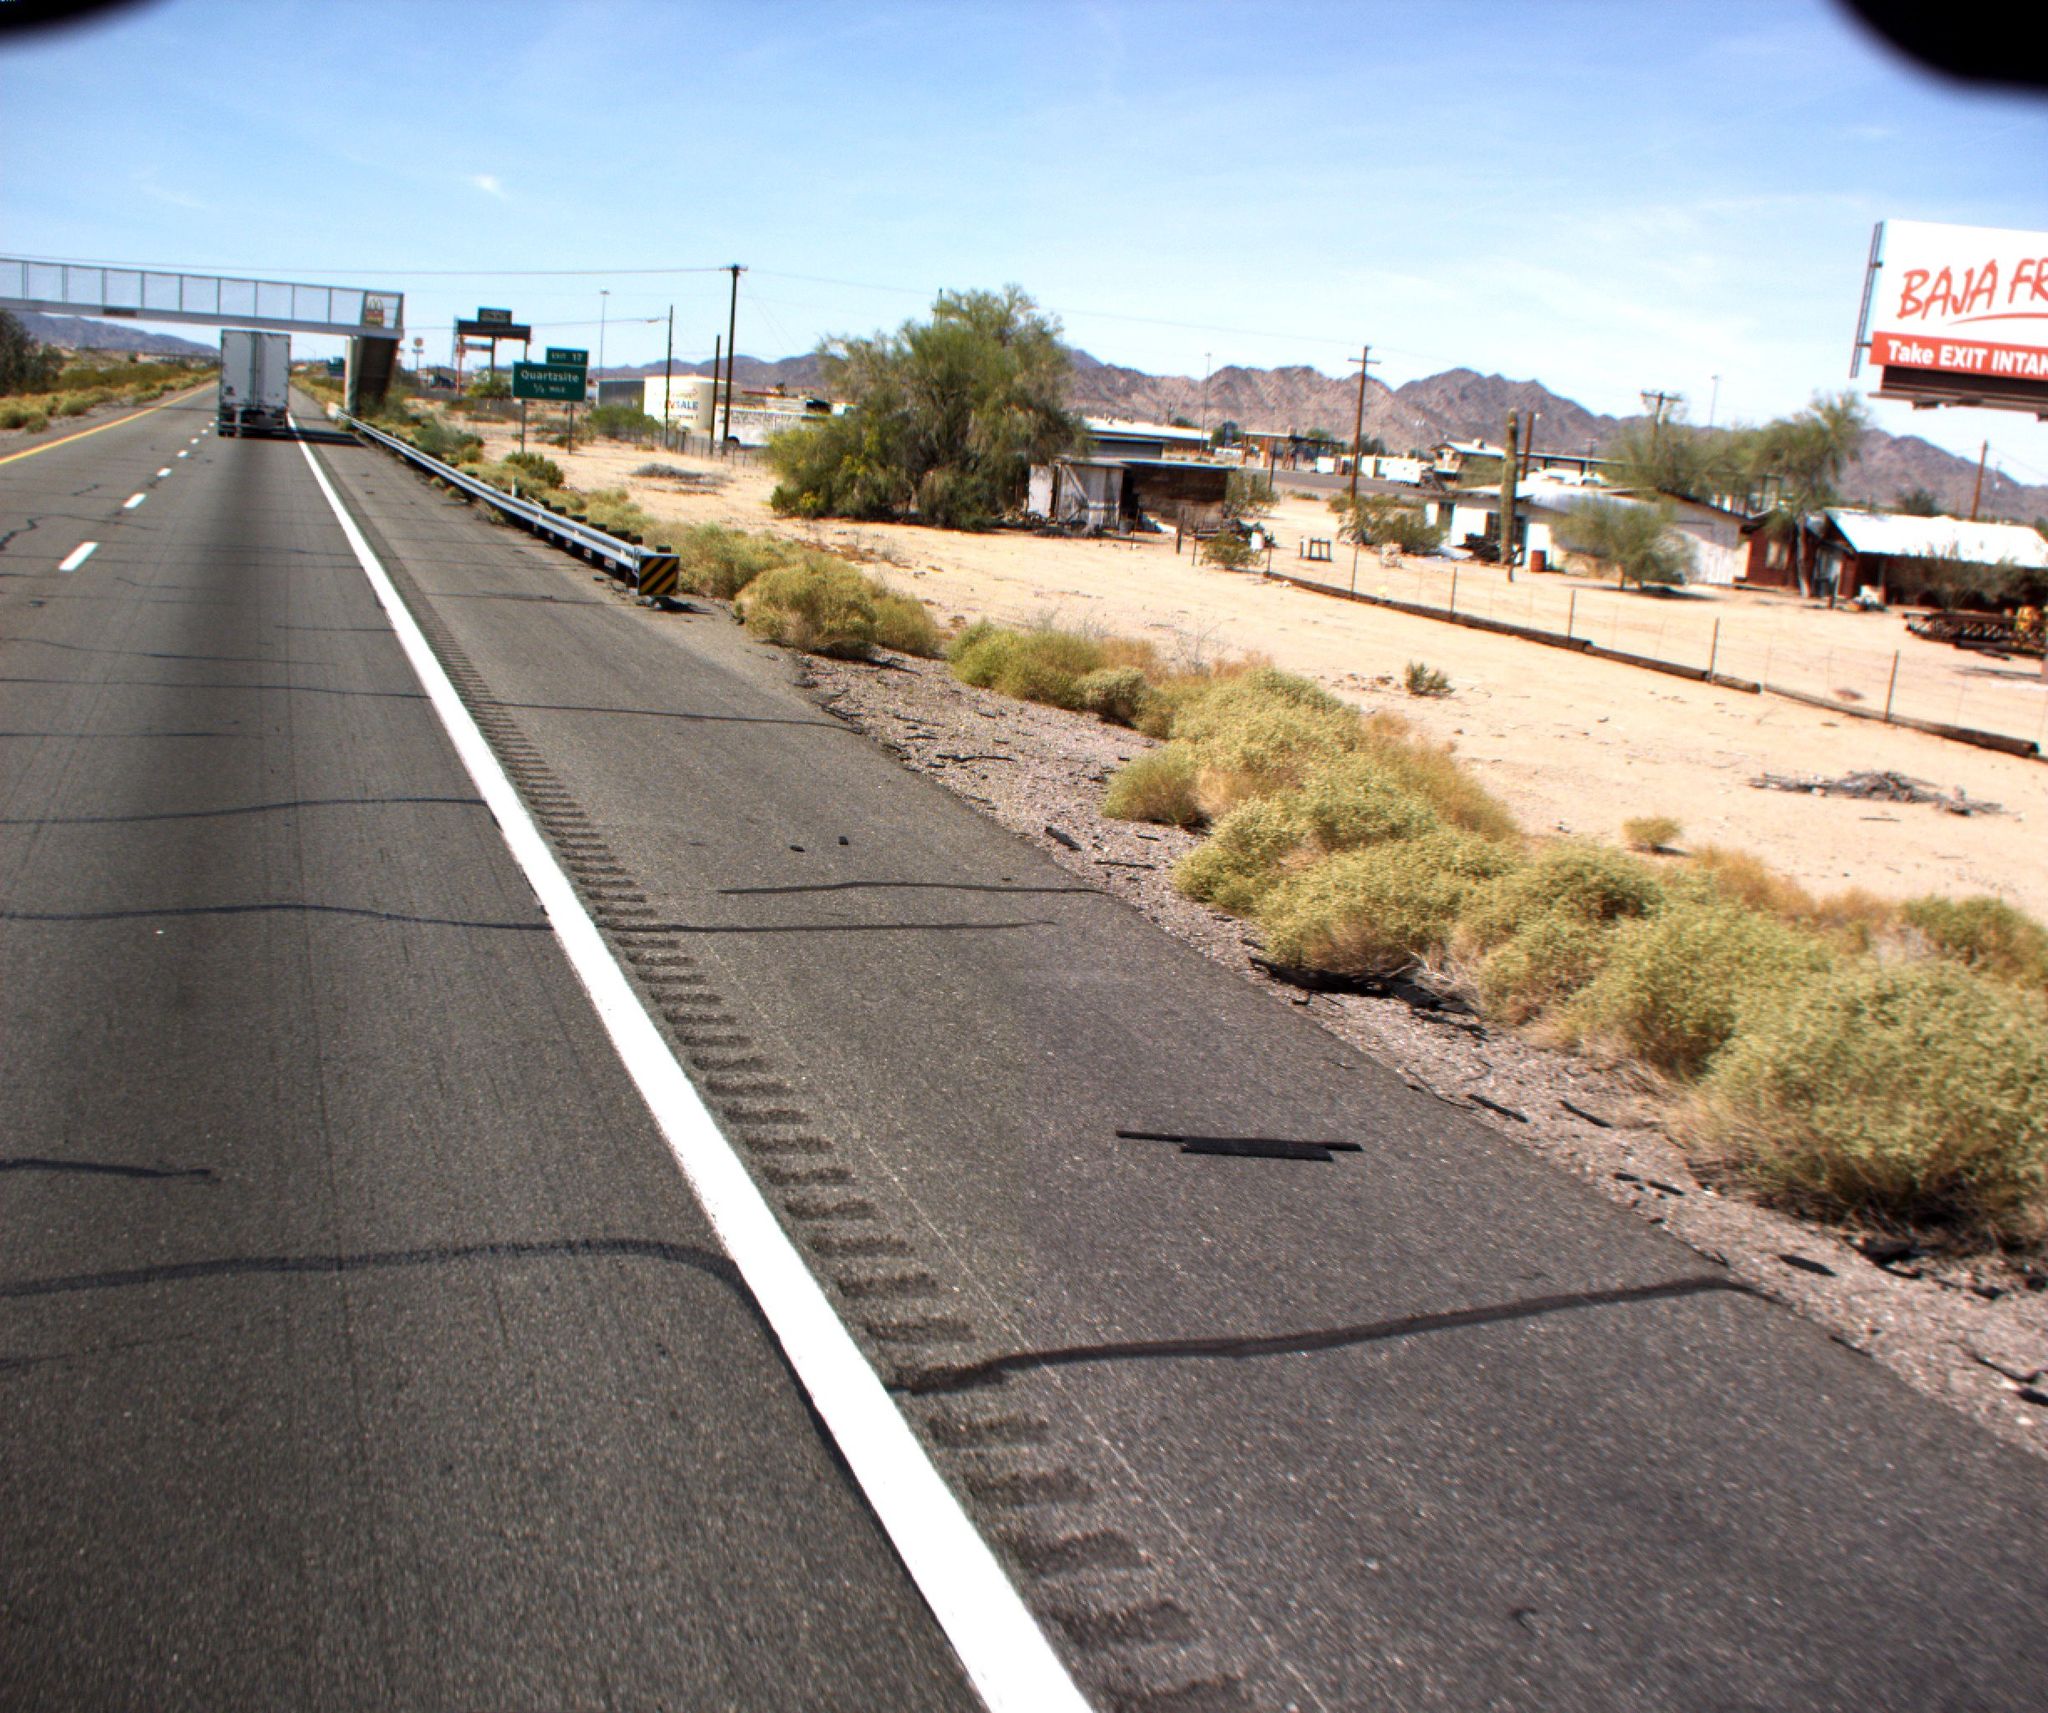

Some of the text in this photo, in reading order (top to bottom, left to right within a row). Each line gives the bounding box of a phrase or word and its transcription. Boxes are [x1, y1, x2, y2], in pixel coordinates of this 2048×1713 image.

[1896, 259, 1998, 320] BAJA
[1889, 340, 1934, 364] Take
[1940, 345, 1988, 368] EXIT
[520, 369, 579, 383] Quartzsite
[676, 399, 699, 410] SALE
